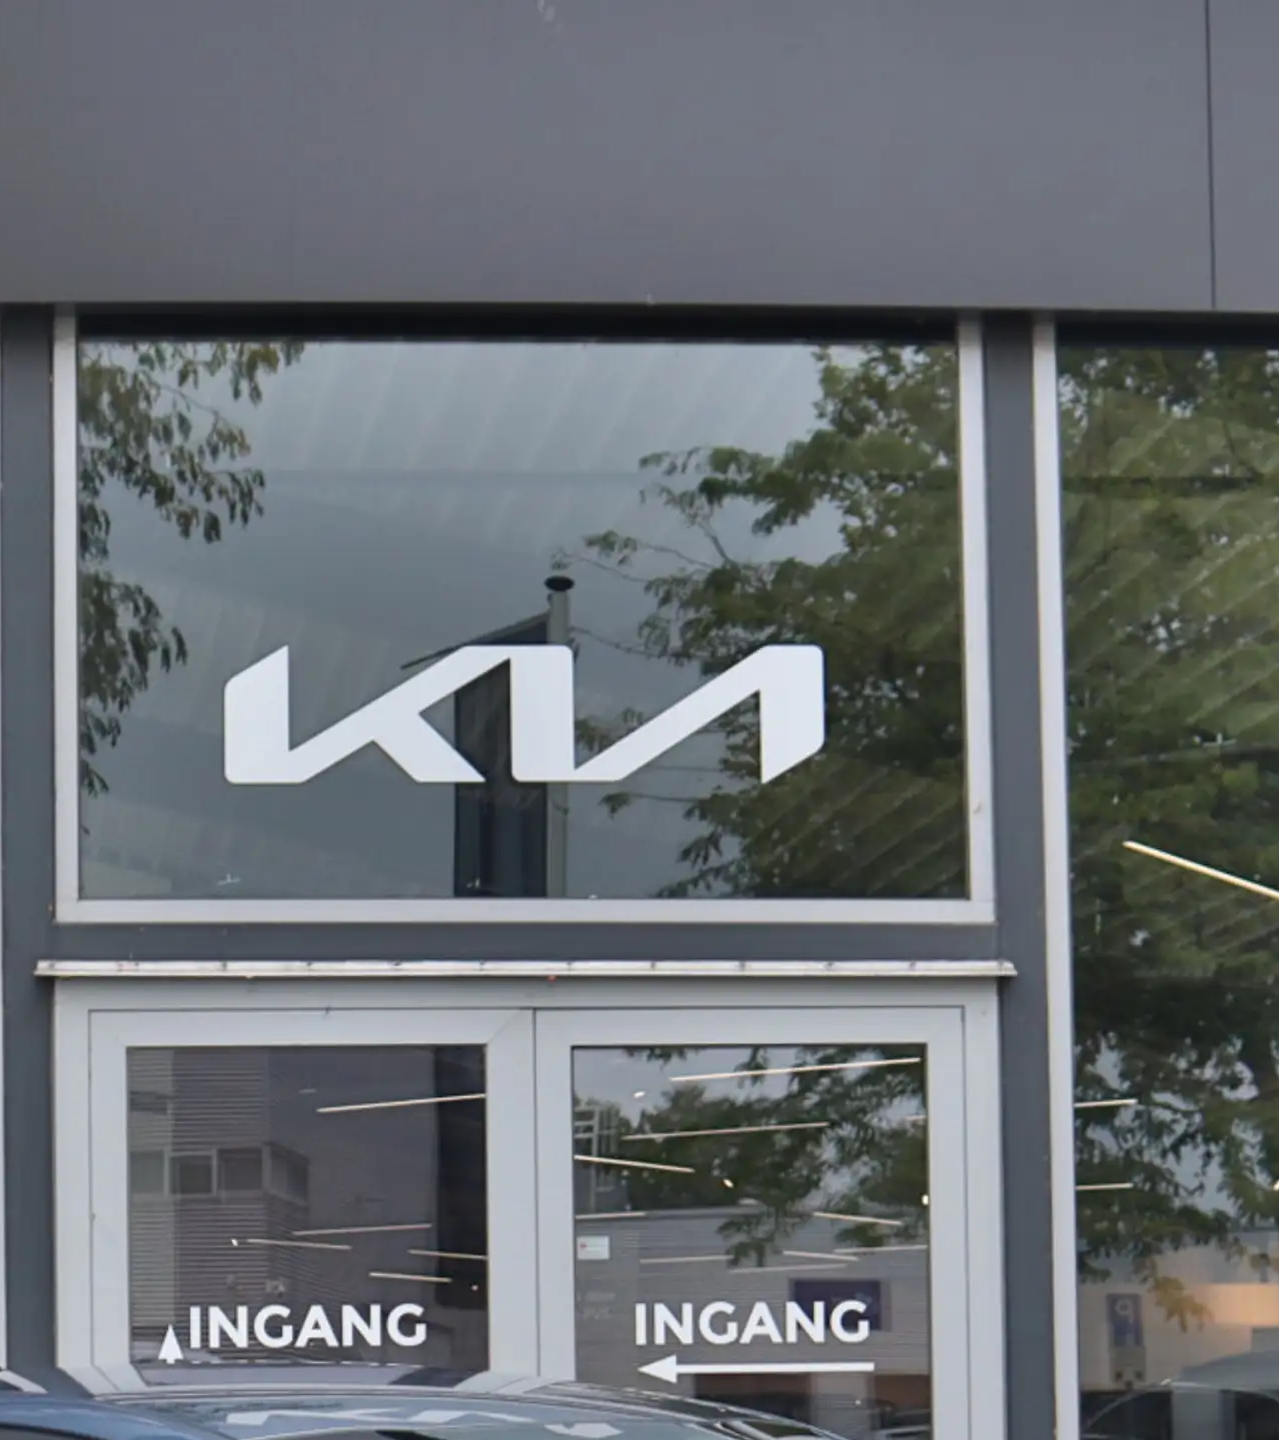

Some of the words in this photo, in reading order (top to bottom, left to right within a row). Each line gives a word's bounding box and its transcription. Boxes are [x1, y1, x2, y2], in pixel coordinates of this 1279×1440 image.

[224, 644, 826, 784] KIA
[189, 1303, 428, 1349] INGANG
[634, 1300, 870, 1345] INGANG
